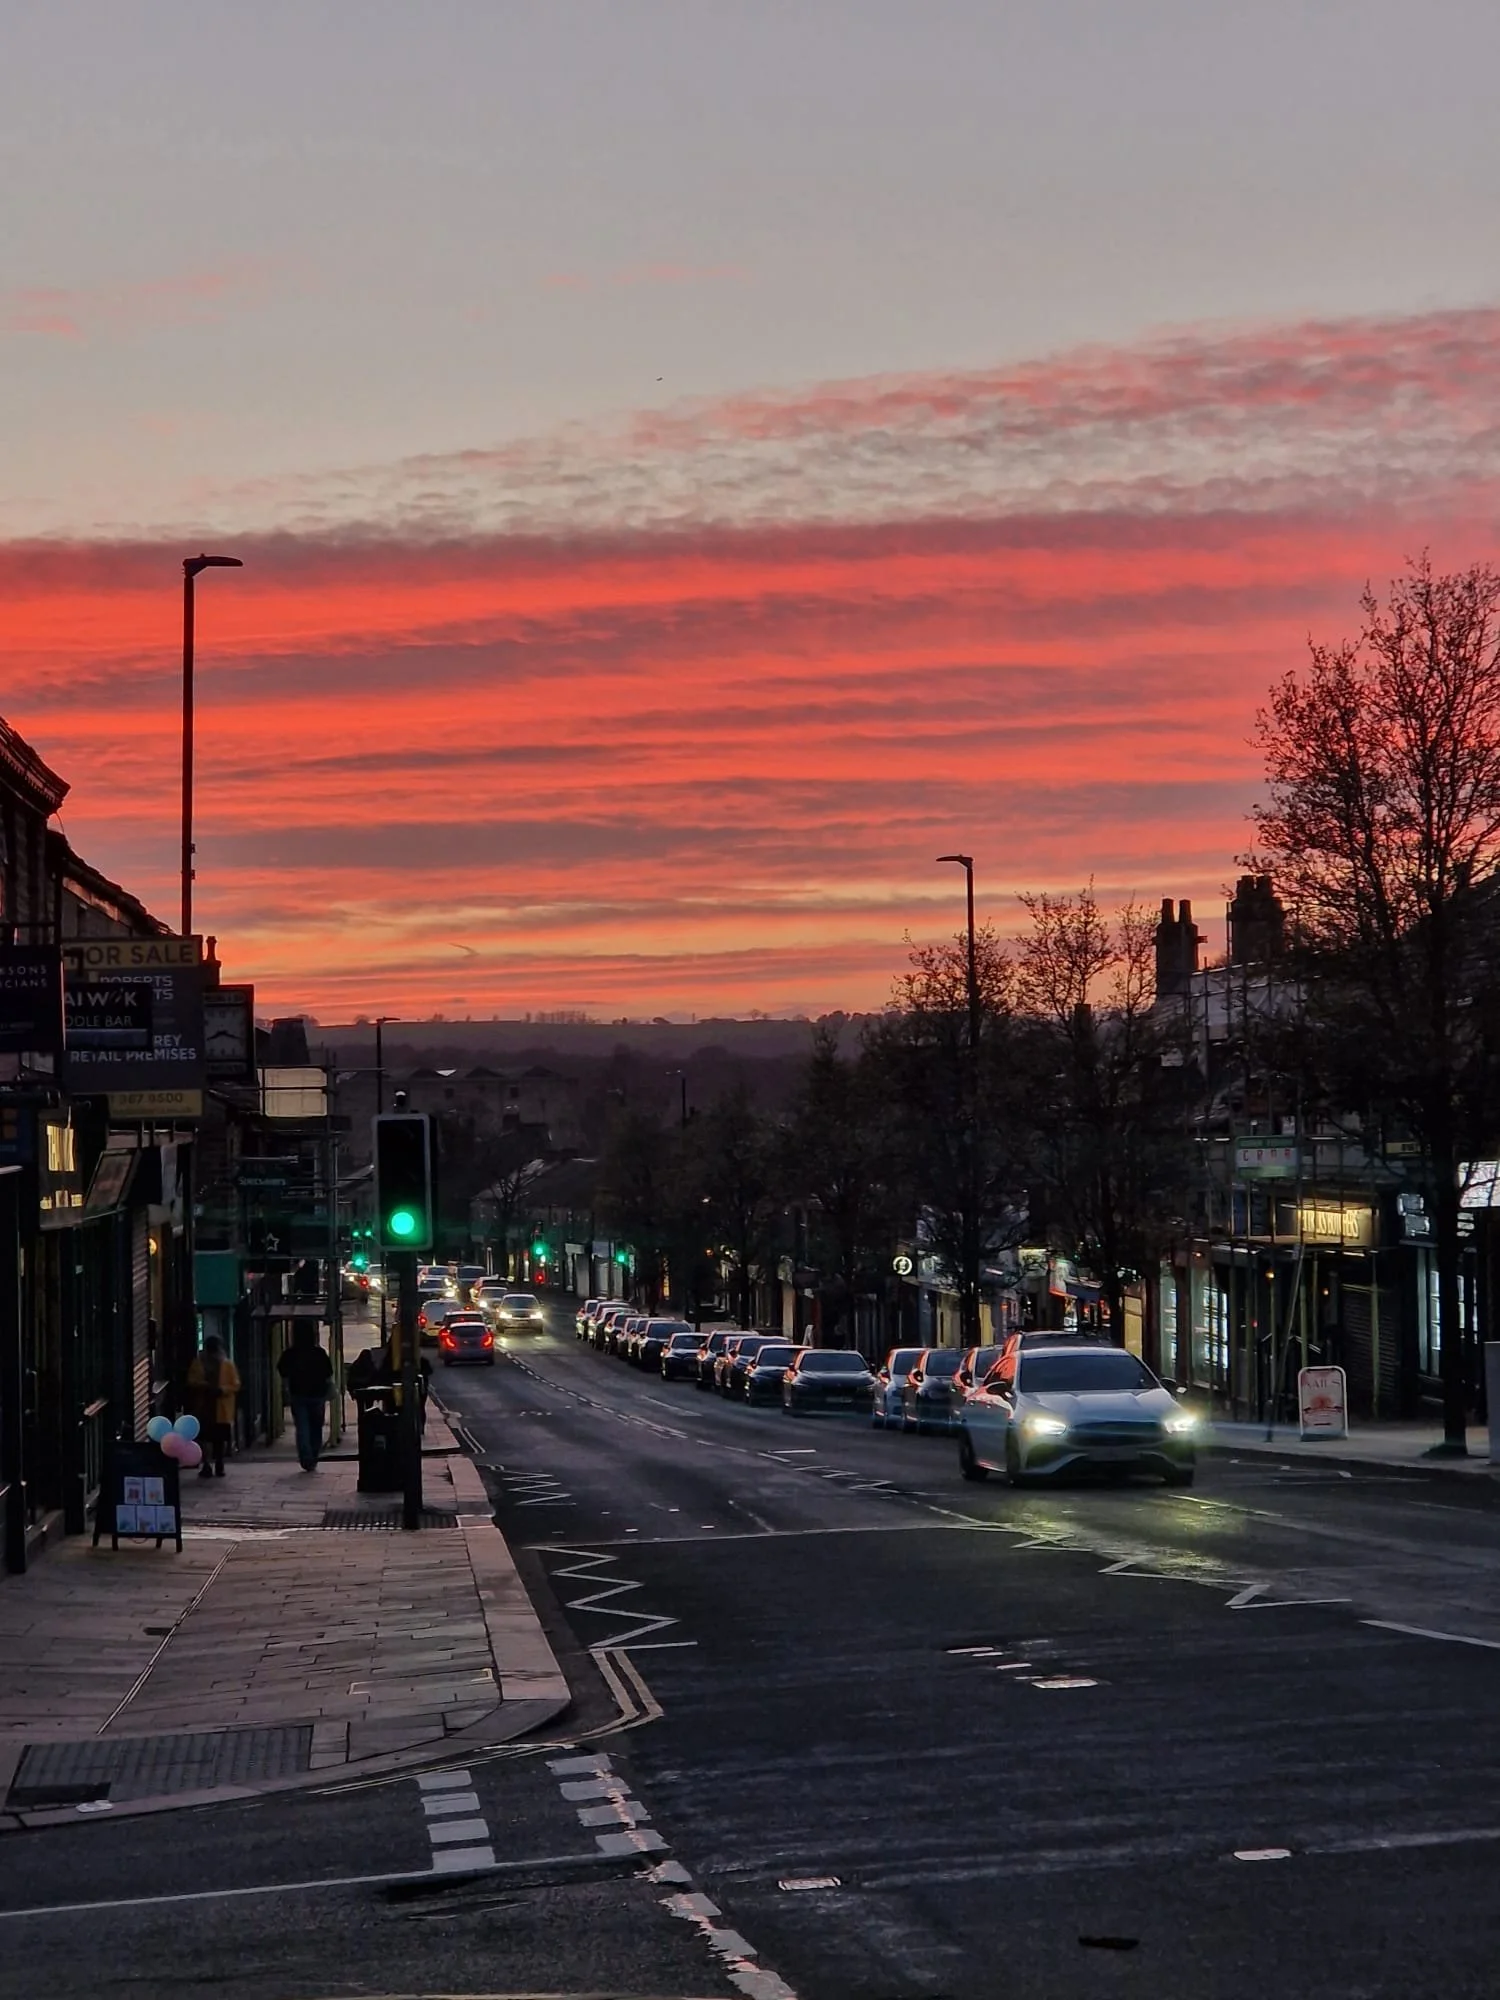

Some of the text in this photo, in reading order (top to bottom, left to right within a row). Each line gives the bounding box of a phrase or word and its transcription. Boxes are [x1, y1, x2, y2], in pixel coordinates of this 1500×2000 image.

[131, 943, 193, 964] SALE
[105, 1014, 134, 1028] BAR
[70, 1047, 197, 1063] RETAIL PREMISES
